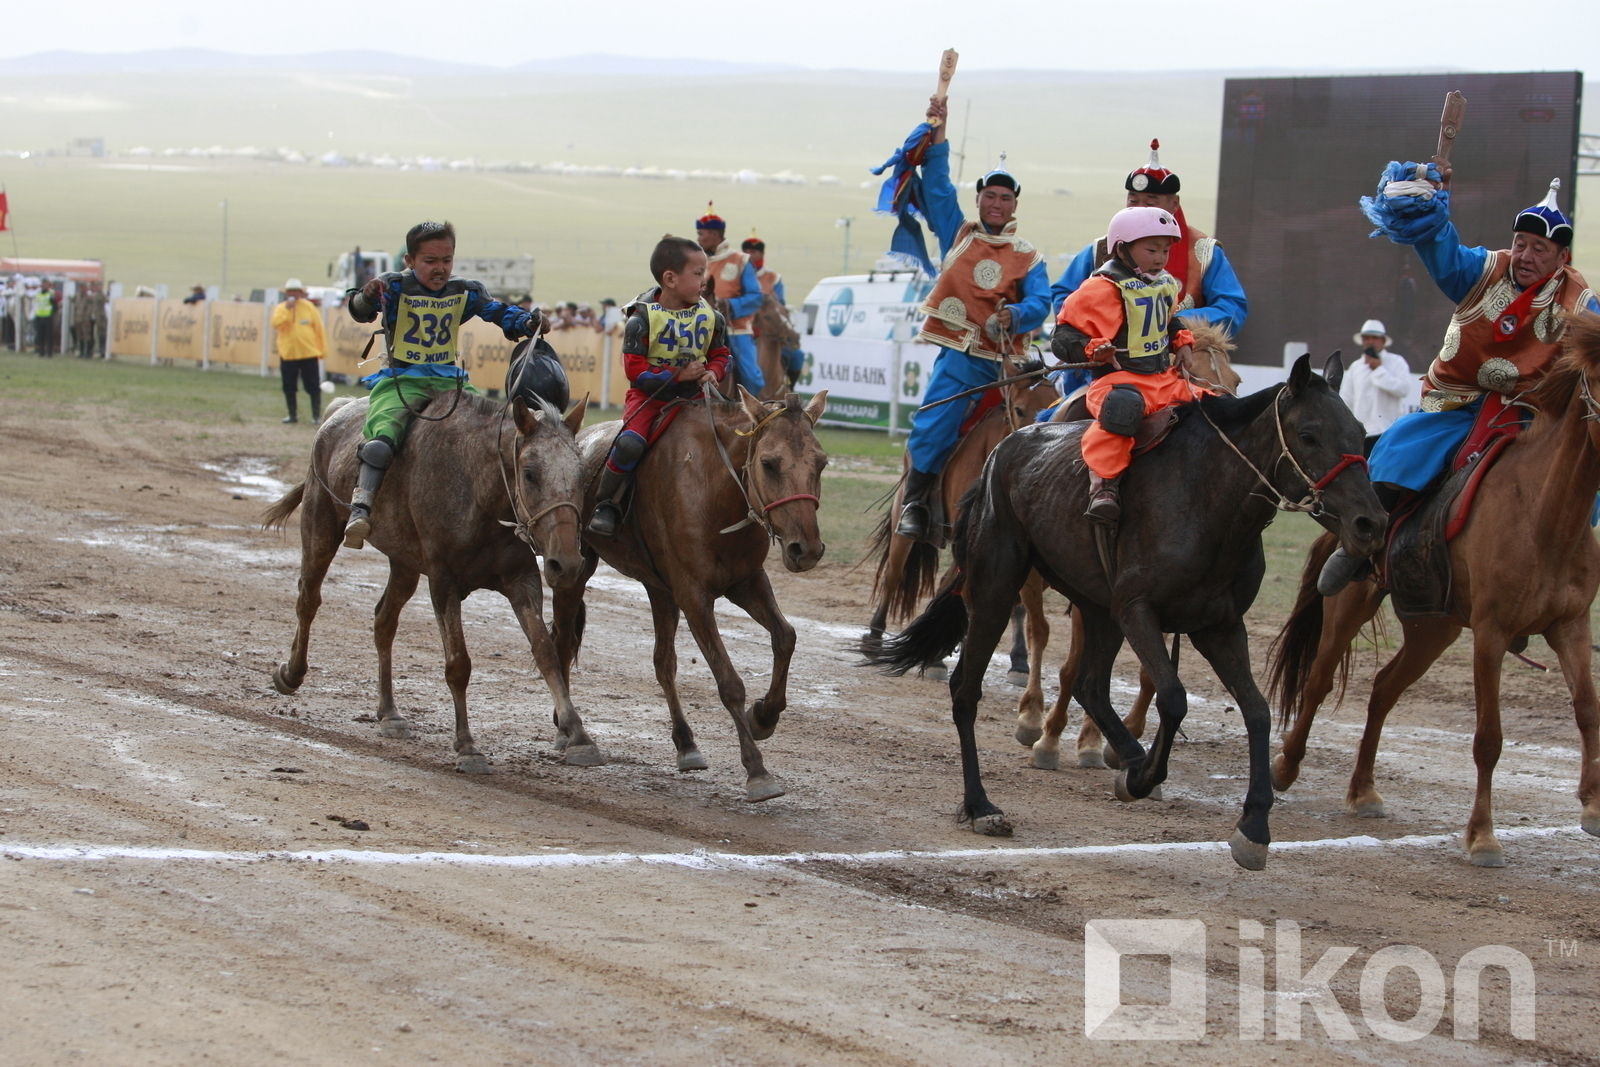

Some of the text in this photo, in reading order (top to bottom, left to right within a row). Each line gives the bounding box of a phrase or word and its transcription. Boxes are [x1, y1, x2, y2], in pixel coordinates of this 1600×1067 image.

[403, 311, 454, 348] 238
[658, 314, 709, 352] 456
[406, 350, 449, 363] 96 ЖИЛ
[1144, 341, 1159, 352] 96
[818, 362, 887, 385] ХААН БАНК
